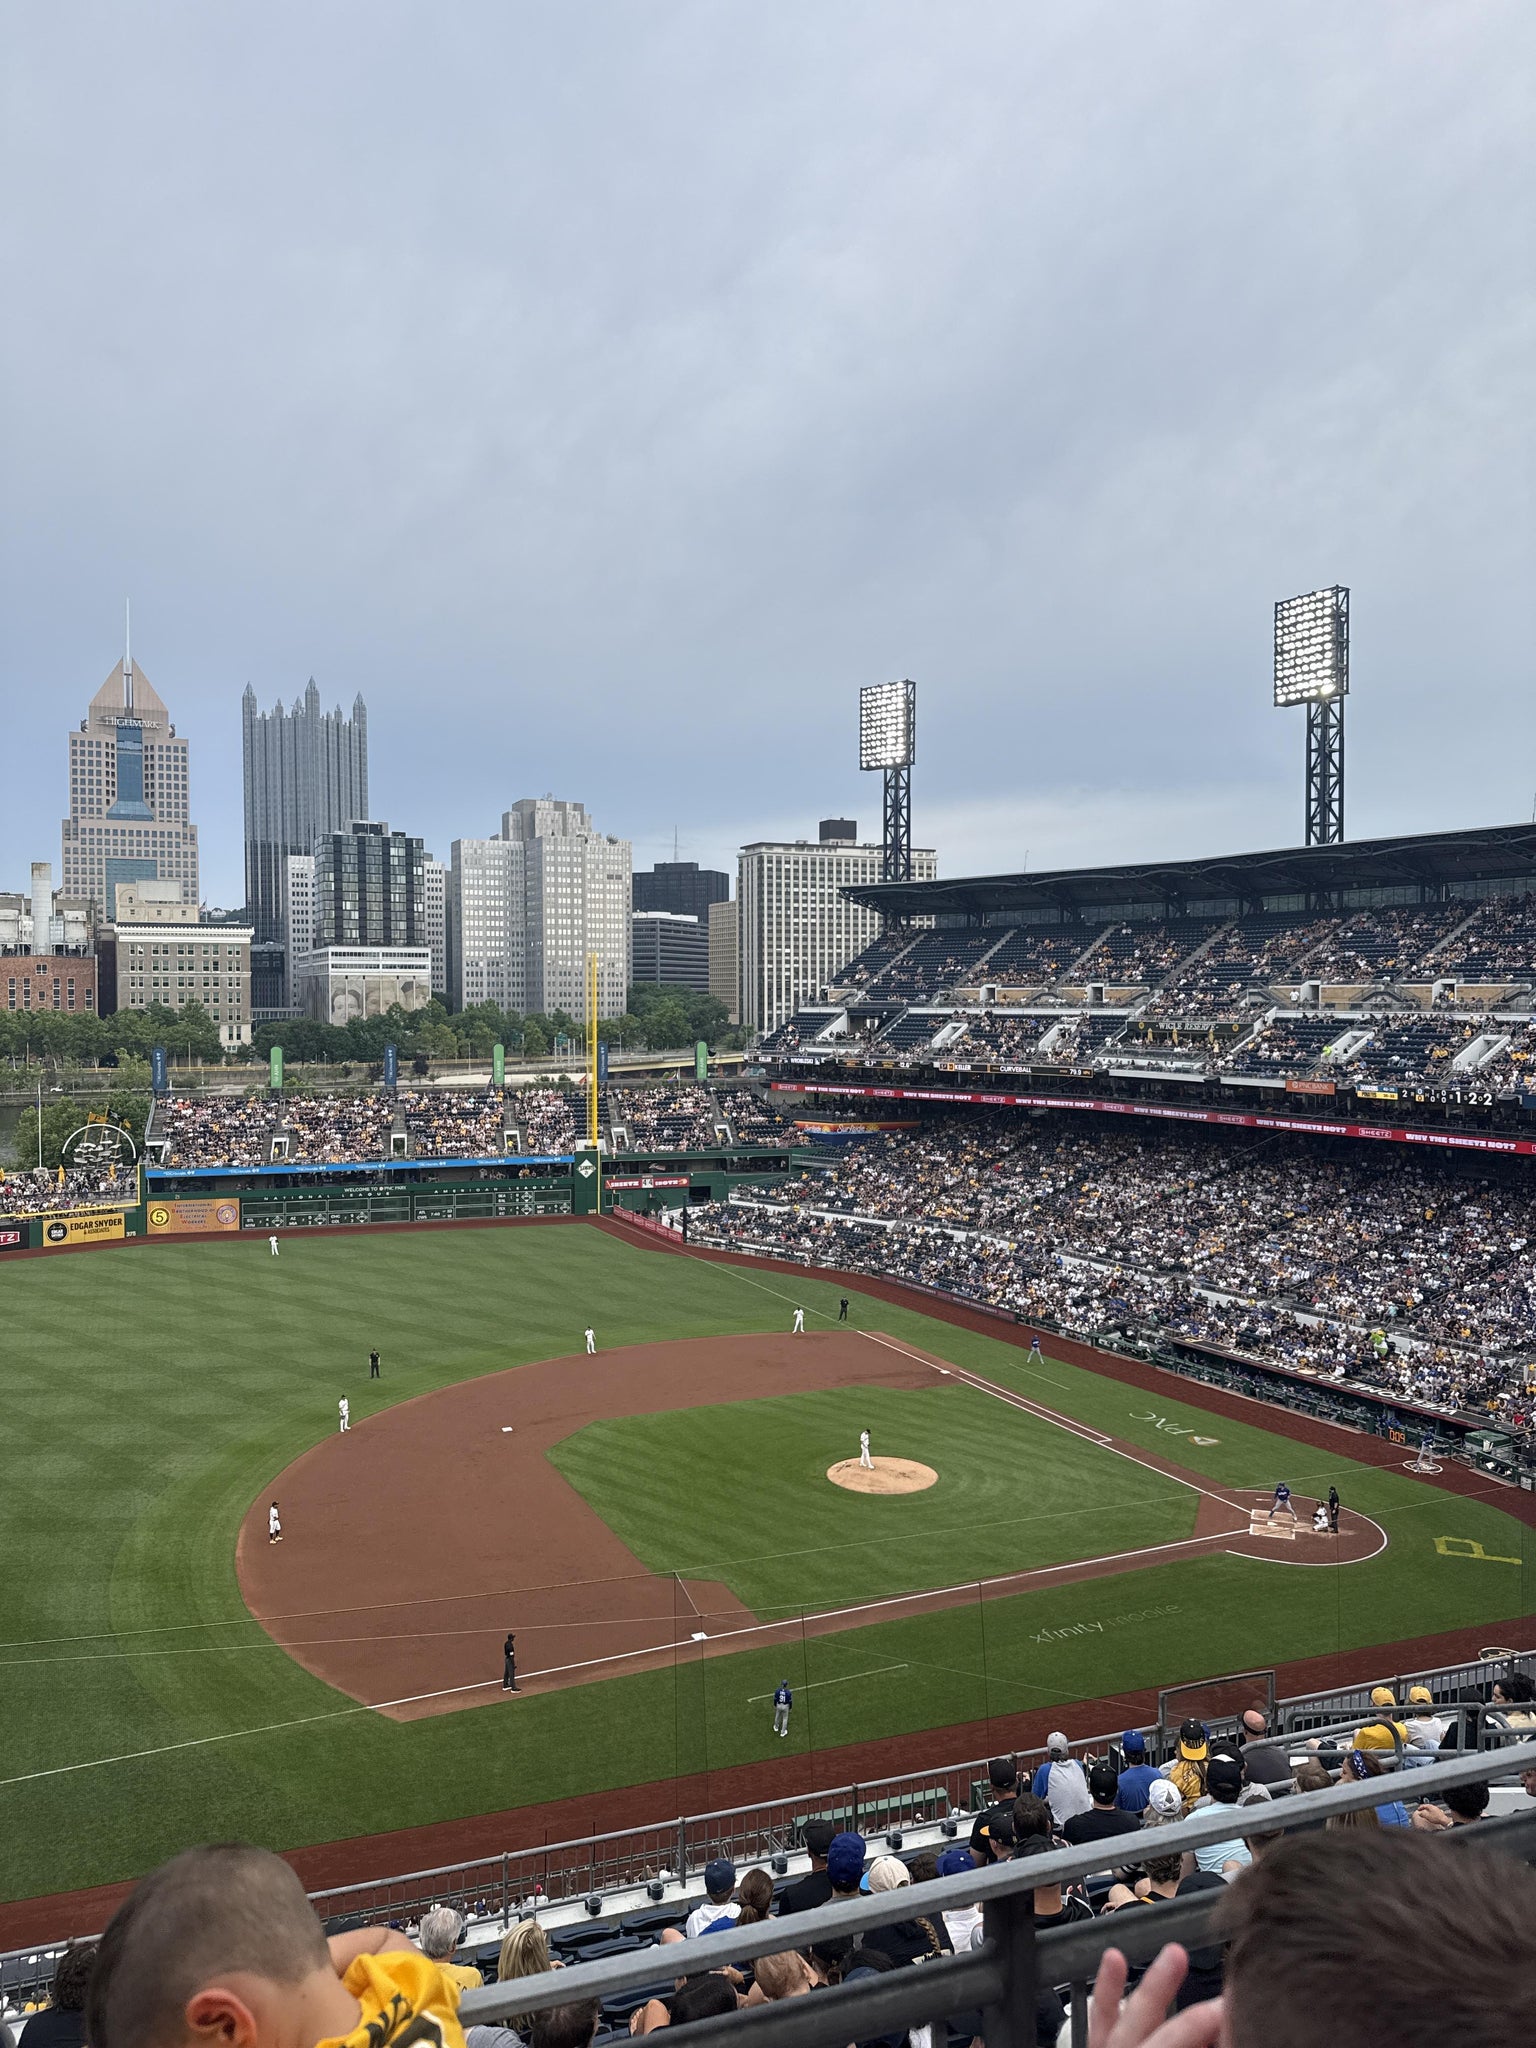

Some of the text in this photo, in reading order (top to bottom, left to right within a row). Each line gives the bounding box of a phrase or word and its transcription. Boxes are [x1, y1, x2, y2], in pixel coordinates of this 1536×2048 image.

[106, 717, 159, 729] HIGHMARK
[1159, 1022, 1216, 1031] WIGLE RESERVE
[1456, 1092, 1460, 1103] 1
[1469, 1093, 1477, 1104] 2
[1483, 1093, 1492, 1105] 2
[1291, 1122, 1322, 1131] SHEETZ
[1323, 1125, 1347, 1133] HOT?
[1405, 1133, 1516, 1150] WHY THE SHEETZ HOT?
[156, 1211, 163, 1222] 5
[71, 1218, 122, 1231] EDGAR SNYDER
[1317, 1374, 1344, 1384] TO
[1347, 1382, 1457, 1415] WELCOME
[1128, 1411, 1195, 1435] PNC
[1029, 1604, 1183, 1643] xfinity mobile
